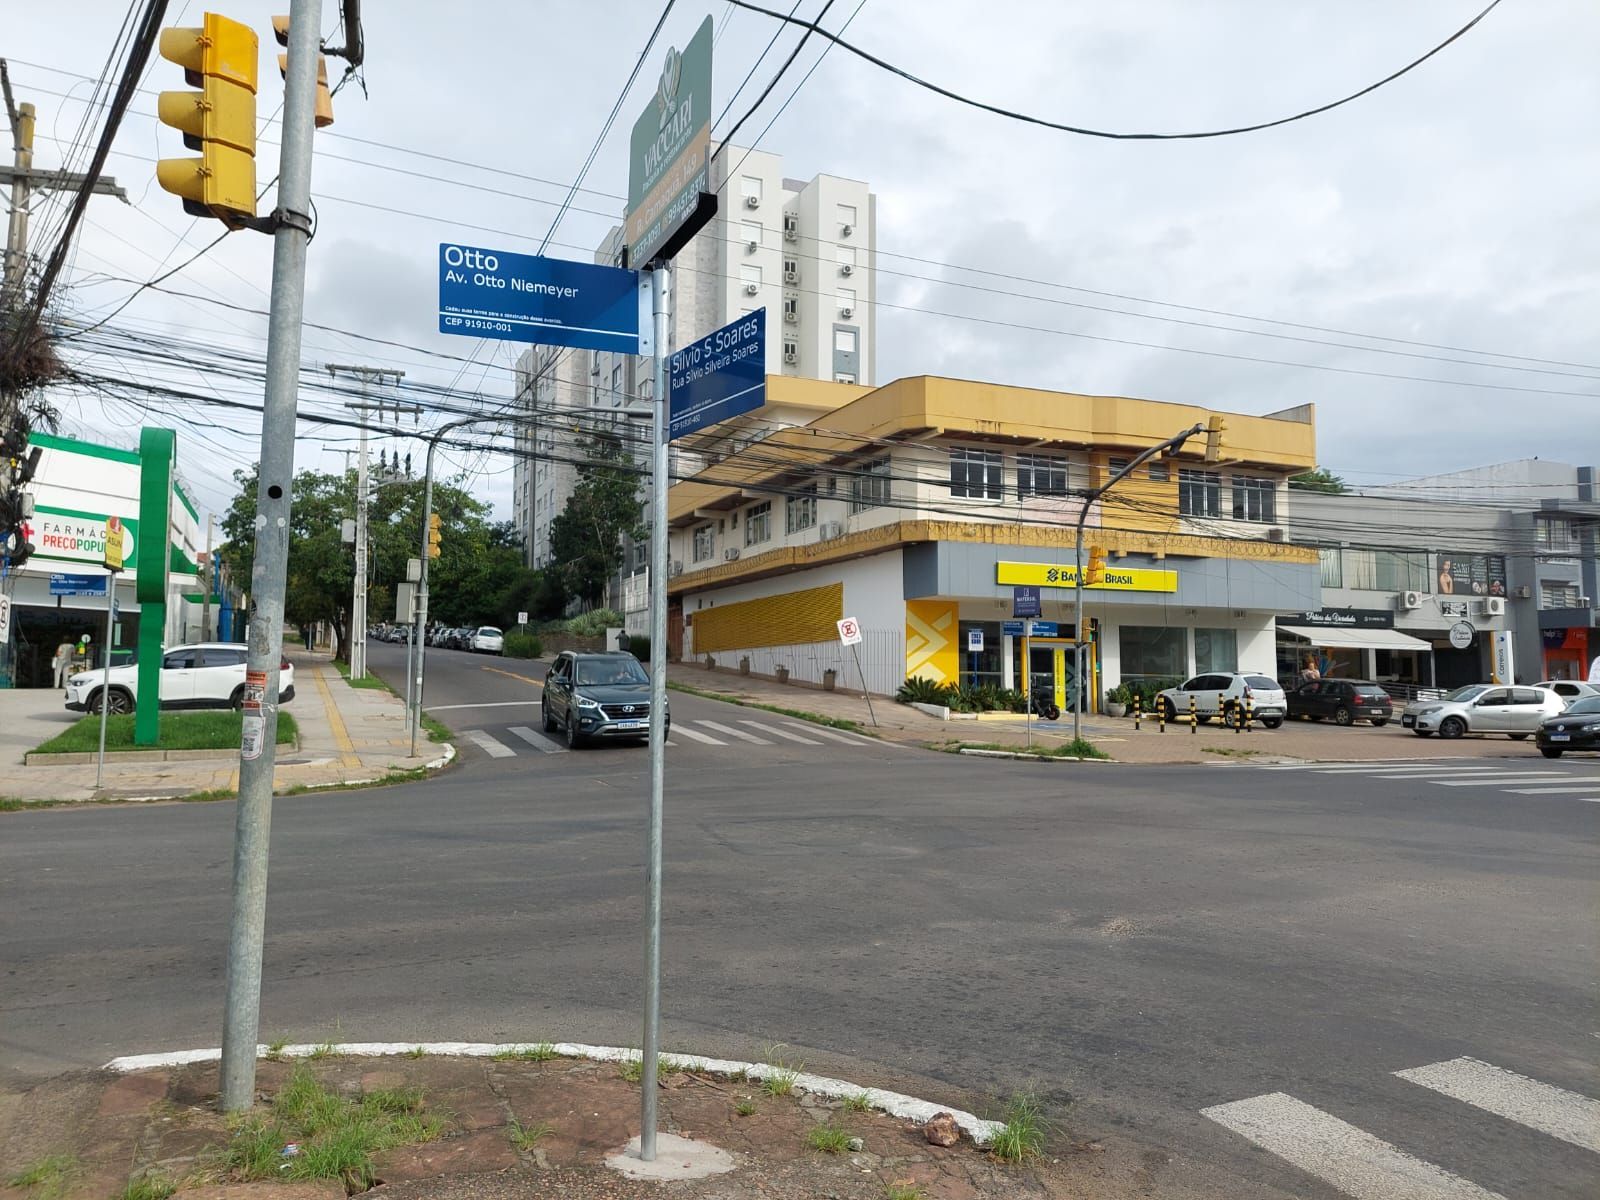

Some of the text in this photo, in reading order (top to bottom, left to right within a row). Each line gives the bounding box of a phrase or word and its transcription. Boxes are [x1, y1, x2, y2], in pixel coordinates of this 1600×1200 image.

[644, 92, 692, 177] VACCARI
[445, 246, 499, 271] Otto
[445, 270, 579, 299] Av. Otto Niemeyer
[445, 317, 512, 332] CEP 91910-001
[672, 318, 758, 374] Silvio S Soares
[672, 342, 759, 390] Rua Silvio Silveira Soares
[43, 522, 106, 539] FARMÁC
[43, 534, 106, 553] PREÇOPOPU
[1105, 573, 1134, 585] BRASIL
